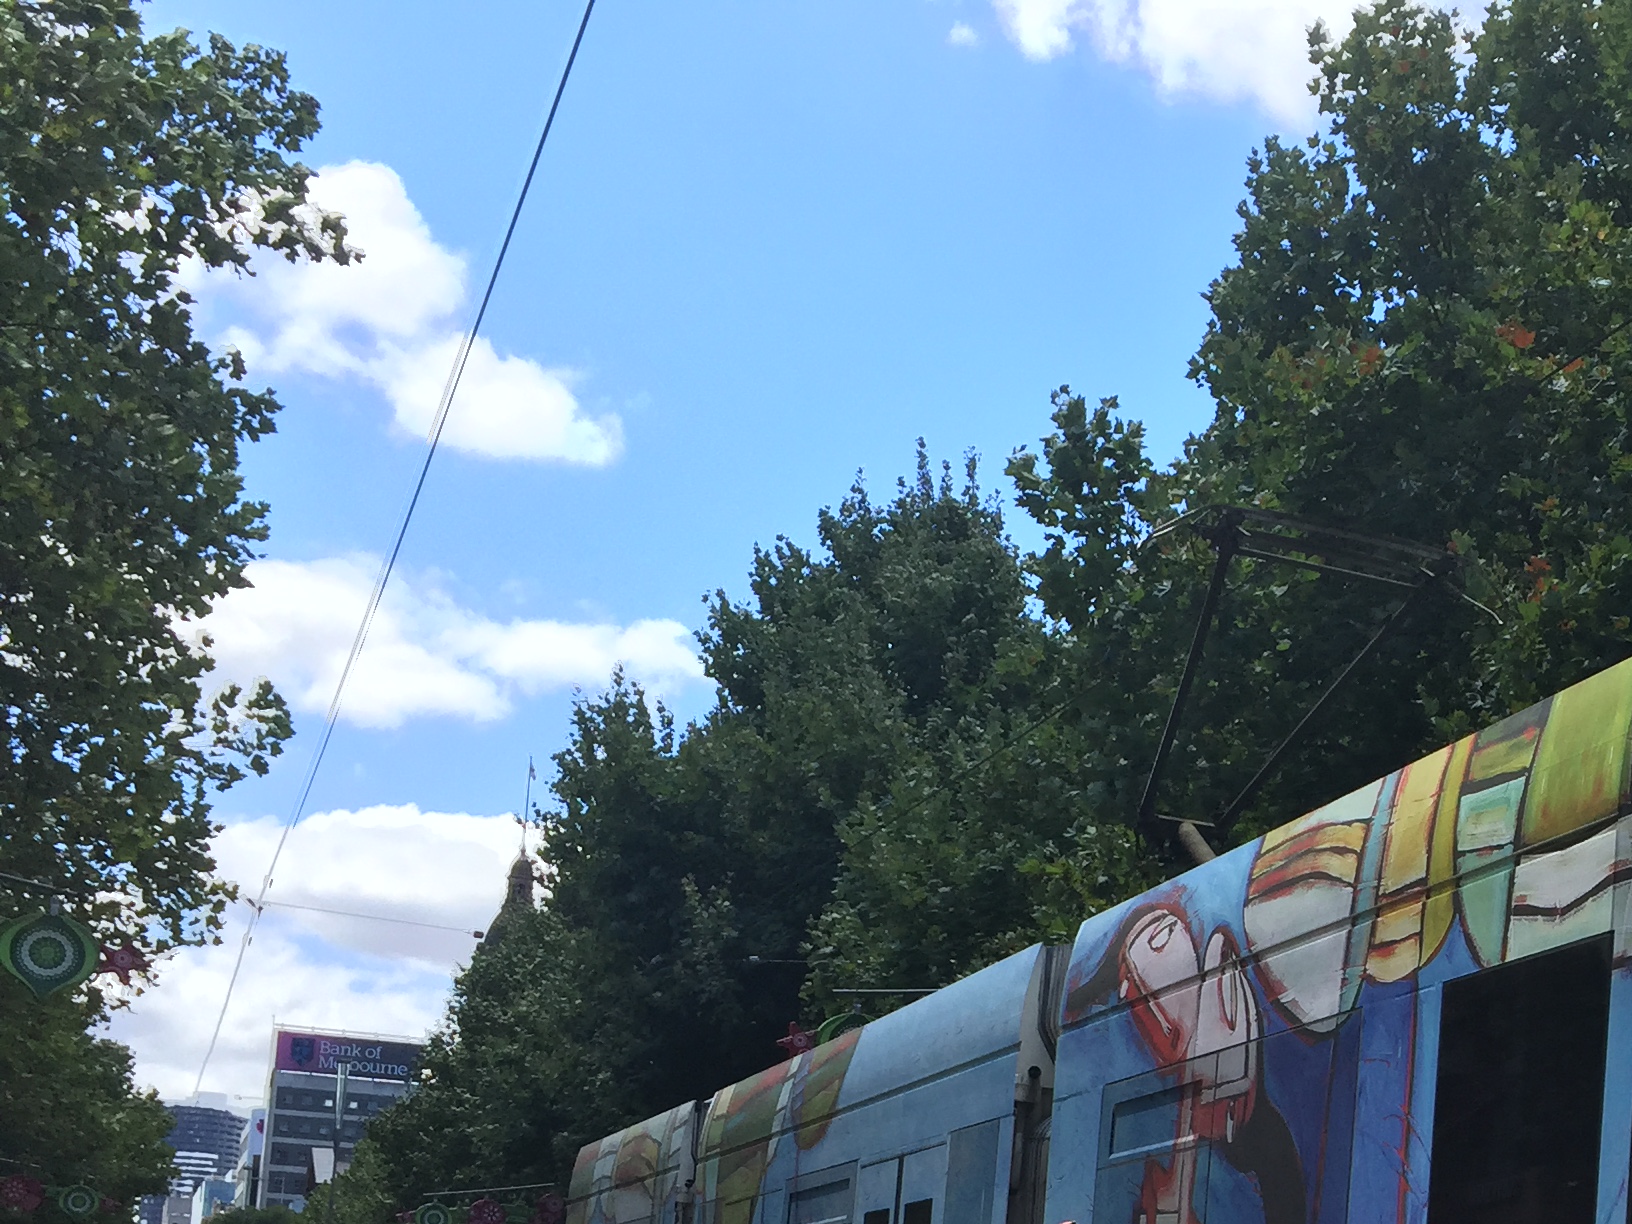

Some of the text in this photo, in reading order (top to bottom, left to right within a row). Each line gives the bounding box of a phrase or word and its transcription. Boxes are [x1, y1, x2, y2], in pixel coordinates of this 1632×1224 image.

[320, 1040, 383, 1059] Bank of
[318, 1056, 408, 1077] Mebourne
